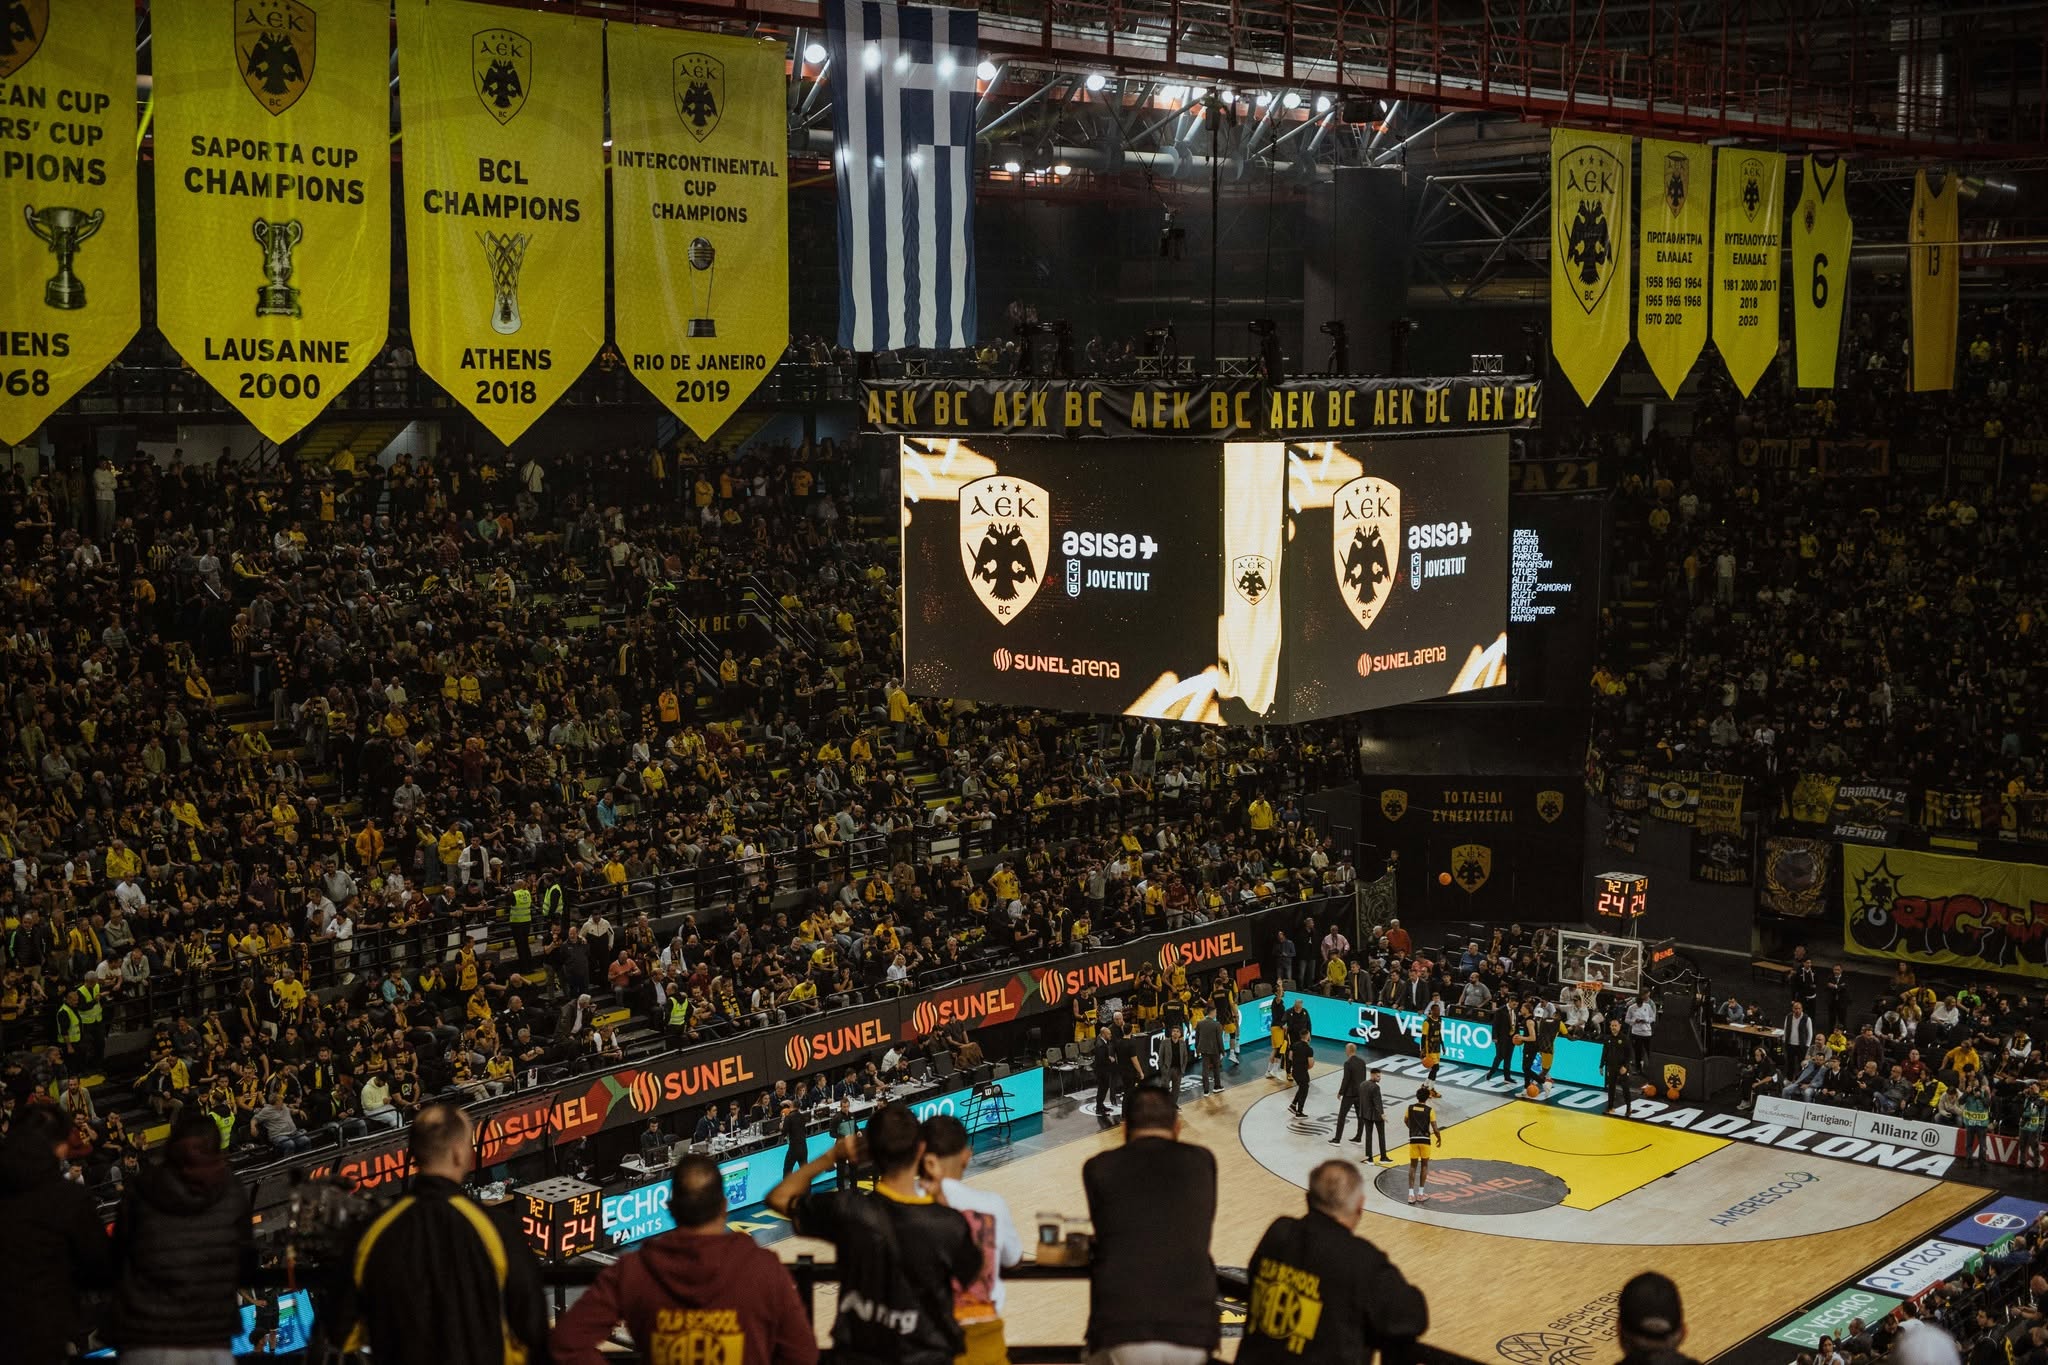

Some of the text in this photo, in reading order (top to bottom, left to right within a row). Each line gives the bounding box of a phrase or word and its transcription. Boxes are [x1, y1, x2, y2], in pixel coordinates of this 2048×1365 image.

[57, 89, 111, 115] CUP
[268, 97, 283, 107] BC
[49, 121, 103, 146] CUP
[191, 135, 359, 169] SAPORTA CUP
[617, 150, 780, 177] INTERCONTINENTAL
[478, 158, 529, 185] BCL
[184, 167, 365, 205] CHAMPIONS
[683, 180, 717, 197] CUP
[423, 189, 581, 223] CHAMPIONS
[652, 202, 748, 224] CHAMPIONS
[1733, 252, 1767, 265] ΕΛΛΑΔΑΣ
[1646, 276, 1663, 288] 1958
[1685, 277, 1702, 289] 1964
[1740, 279, 1758, 291] 2000
[1812, 253, 1828, 308] 6
[1584, 290, 1594, 301] BC
[1645, 295, 1662, 307] 1965
[1740, 297, 1758, 309] 2018
[1645, 313, 1662, 325] 1970
[1738, 315, 1758, 327] 2020
[204, 337, 350, 364] LAUSANNE
[460, 348, 552, 371] ATHENS
[633, 354, 767, 371] RIO DE JANEIRO
[239, 372, 321, 400] 2000
[475, 380, 537, 404] 2018
[675, 379, 731, 403] 2019
[867, 390, 1251, 429] AEK BC AEK BC AEK BC
[1270, 385, 1538, 429] AEK BC AEK BC AEK BC
[1555, 461, 1599, 489] 21
[1062, 530, 1137, 559] asisa
[1408, 522, 1458, 550] asisa
[1513, 529, 1539, 537] DRELL
[1512, 545, 1539, 553] RUBIO
[1424, 556, 1467, 579] JOVENTUT
[1512, 560, 1553, 568] HAKANSON
[1086, 569, 1150, 592] JOVENTUT
[1511, 591, 1537, 599] RUZIC
[1511, 599, 1532, 607] HUNT
[998, 605, 1011, 615] BC
[1362, 608, 1371, 620] BC
[1510, 606, 1556, 614] BIRGANDER
[1510, 614, 1536, 622] HANGA
[712, 616, 731, 632] BC
[1014, 654, 1120, 679] SUNEL arena
[1373, 645, 1447, 672] SUNEL arena
[1462, 791, 1503, 804] ΤΑΞΙΔΙ
[1840, 786, 1892, 800] ORIGINAL
[1432, 809, 1513, 823] ΣΥΝΕΧΙΖΕΤΑΙ
[1833, 824, 1888, 840] MENIDI
[1604, 879, 1629, 894] 7:21
[1635, 878, 1648, 892] 7:21
[1598, 893, 1624, 913] 24
[1630, 893, 1645, 914] 24
[1179, 931, 1244, 967] SUNEL
[1066, 958, 1135, 996] SUNEL
[939, 988, 1014, 1025] SUNEL
[811, 1018, 891, 1059] SUNEL
[1395, 1012, 1493, 1050] VEHRO
[665, 1054, 754, 1094] SUNEL
[506, 1096, 598, 1146] SUNEL
[1871, 1122, 1918, 1141] Allianz
[1614, 1098, 1956, 1176] BADALONA
[1428, 1176, 1534, 1202] SUNEL
[526, 1196, 553, 1221] 7:21
[568, 1191, 600, 1216] 7:21
[602, 1185, 673, 1229] ECHR
[1709, 1181, 1803, 1227] AMERESCO
[562, 1215, 596, 1251] 24
[613, 1218, 662, 1244] PAINTS
[1889, 1243, 1961, 1277] orizon
[1804, 1293, 1875, 1329] VECHRO
